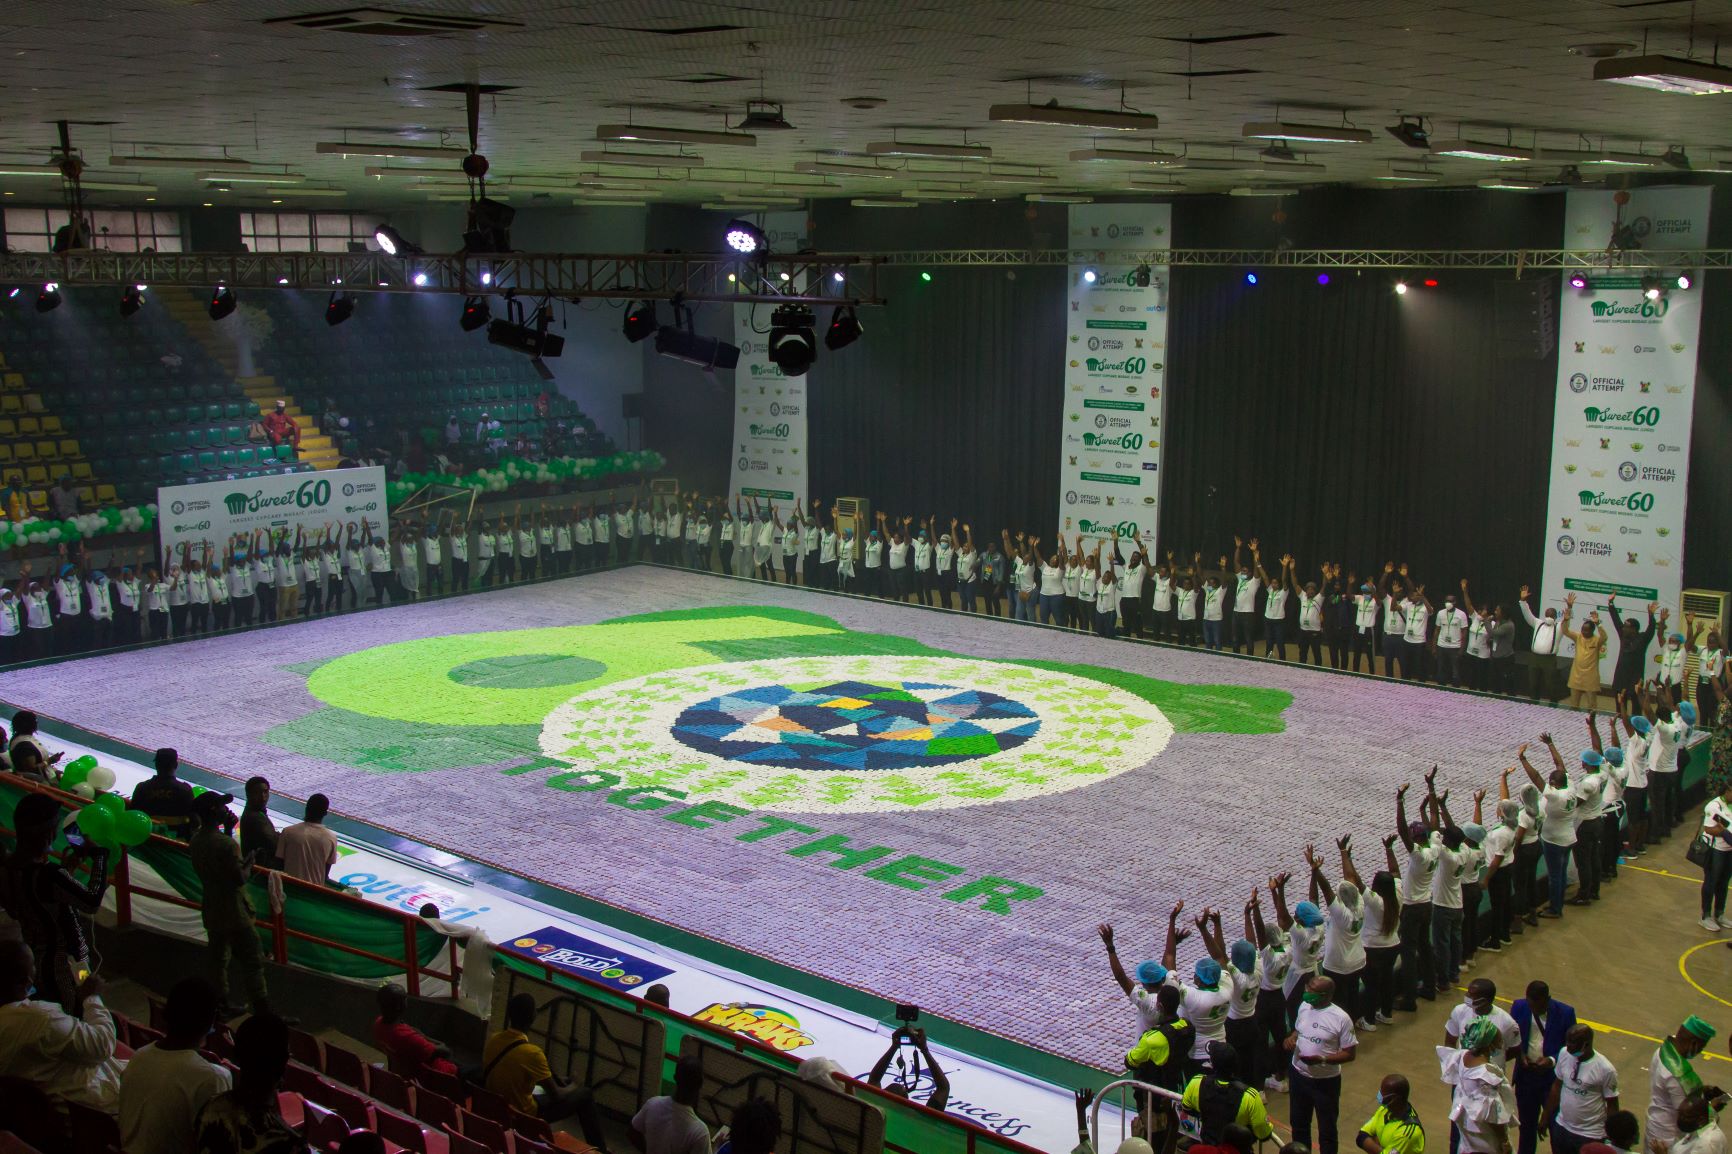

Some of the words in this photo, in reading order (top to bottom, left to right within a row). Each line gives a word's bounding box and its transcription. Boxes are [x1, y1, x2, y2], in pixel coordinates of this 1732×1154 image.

[1656, 219, 1692, 227] OFFICIAL
[1656, 226, 1691, 234] ATTEMPT
[1592, 377, 1625, 386] OFFICIAL
[1592, 384, 1625, 393] ATTEMPT
[1642, 466, 1677, 476] OFFICIAL
[1642, 474, 1676, 483] ATTEMPT
[1579, 540, 1613, 550] OFFICIAL
[1579, 547, 1612, 557] ATTEMPT
[500, 753, 1045, 916] TOGETHER
[544, 949, 613, 971] BOLD
[691, 1002, 815, 1051] KRAKS
